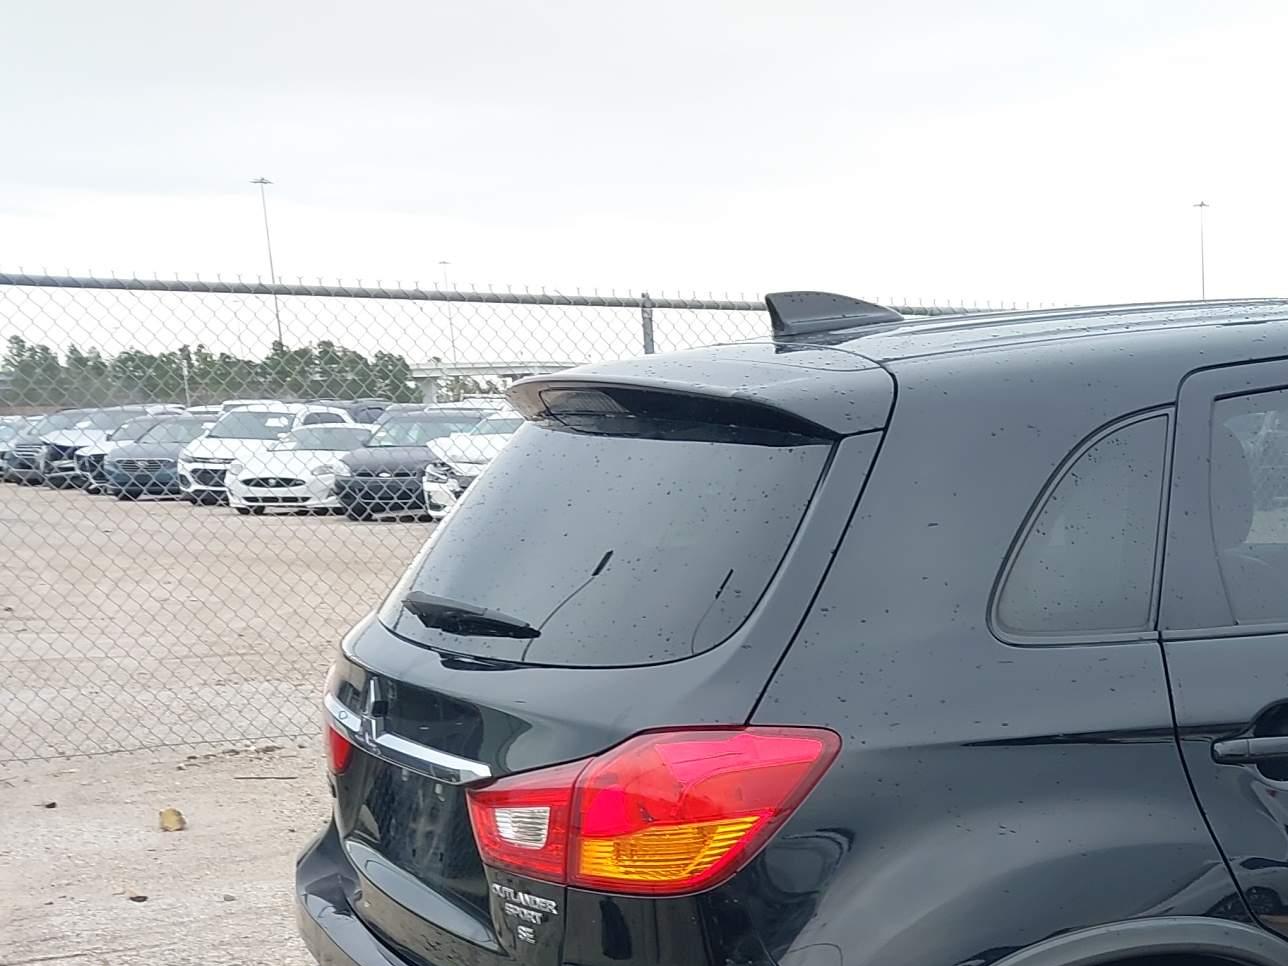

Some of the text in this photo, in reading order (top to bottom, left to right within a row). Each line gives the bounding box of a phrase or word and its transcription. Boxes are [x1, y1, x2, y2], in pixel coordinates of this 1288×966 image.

[491, 883, 559, 915] OUTLANDER
[504, 902, 543, 925] SPORT
[517, 925, 536, 944] SE
